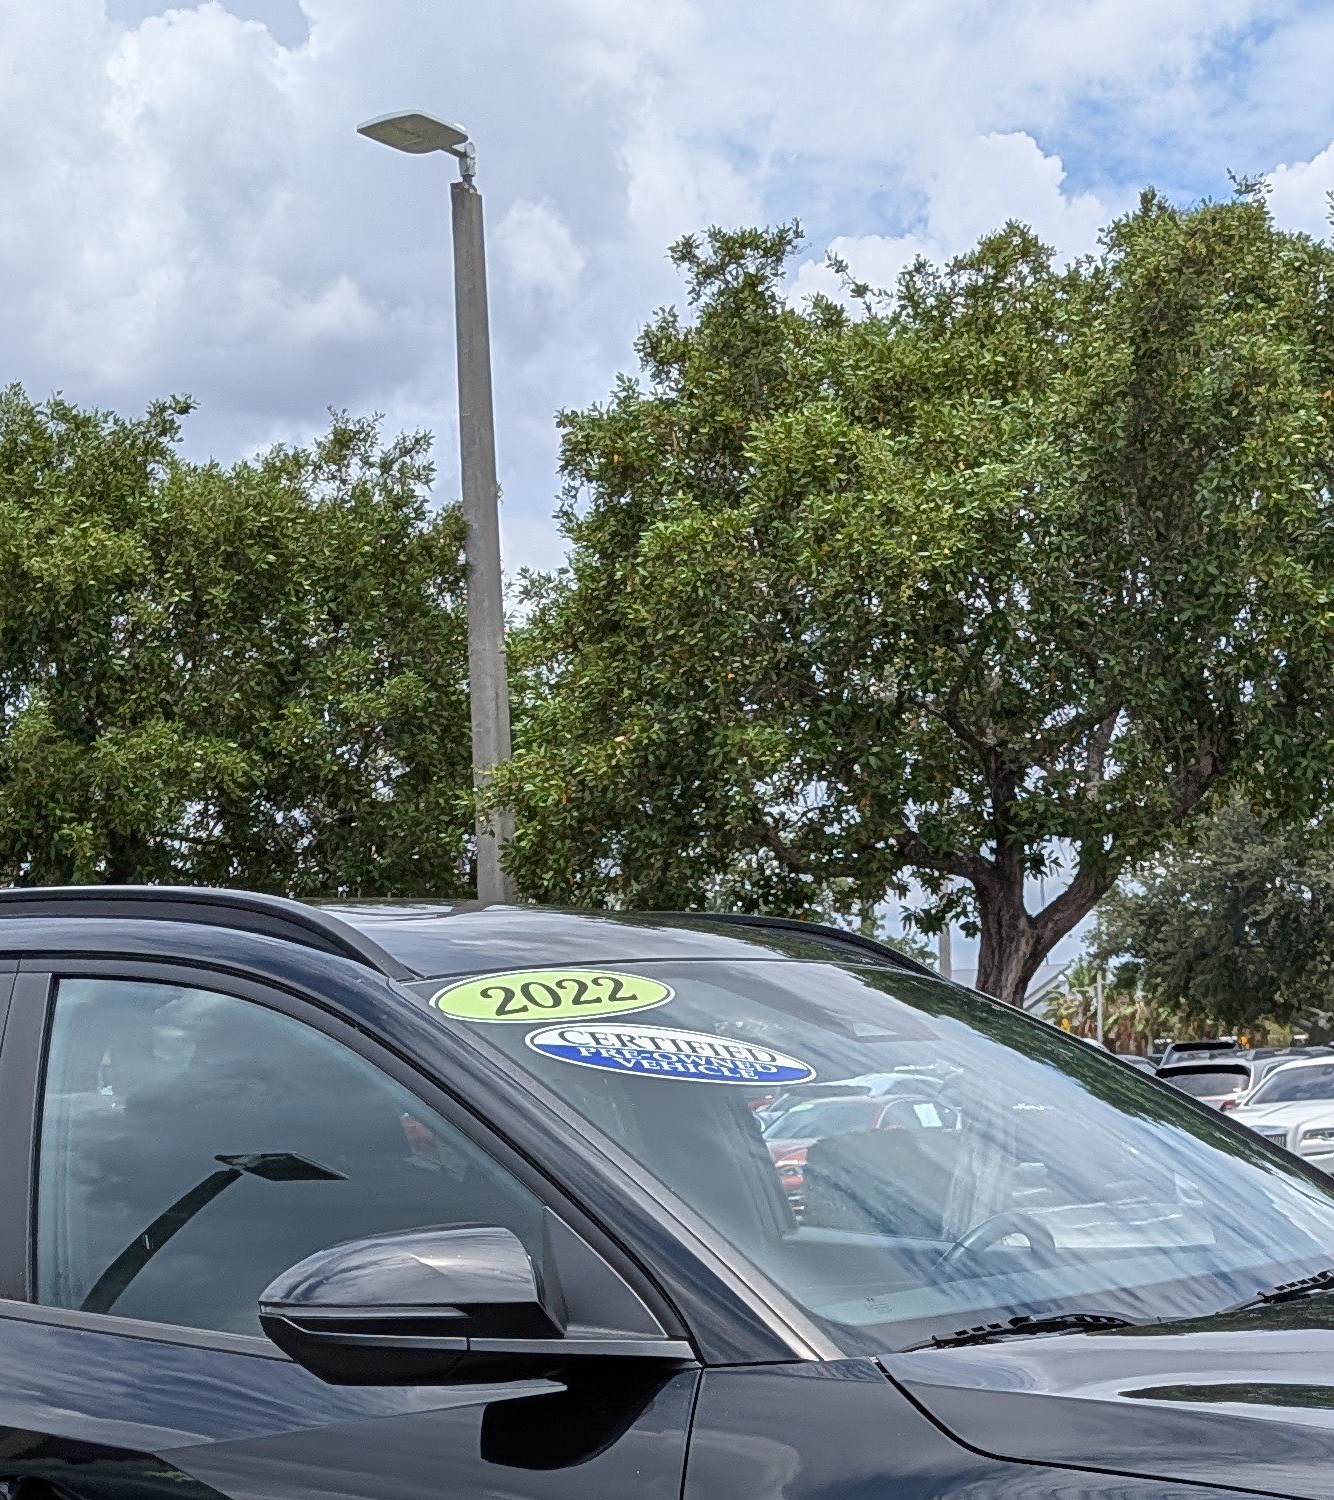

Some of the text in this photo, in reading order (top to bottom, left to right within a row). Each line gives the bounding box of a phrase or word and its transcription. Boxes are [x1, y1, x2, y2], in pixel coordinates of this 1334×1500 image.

[479, 975, 640, 1017] 2022
[557, 1029, 778, 1064] CERTIFIED
[578, 1046, 779, 1073] PRE-OWNED
[614, 1058, 760, 1080] VEHICLE
